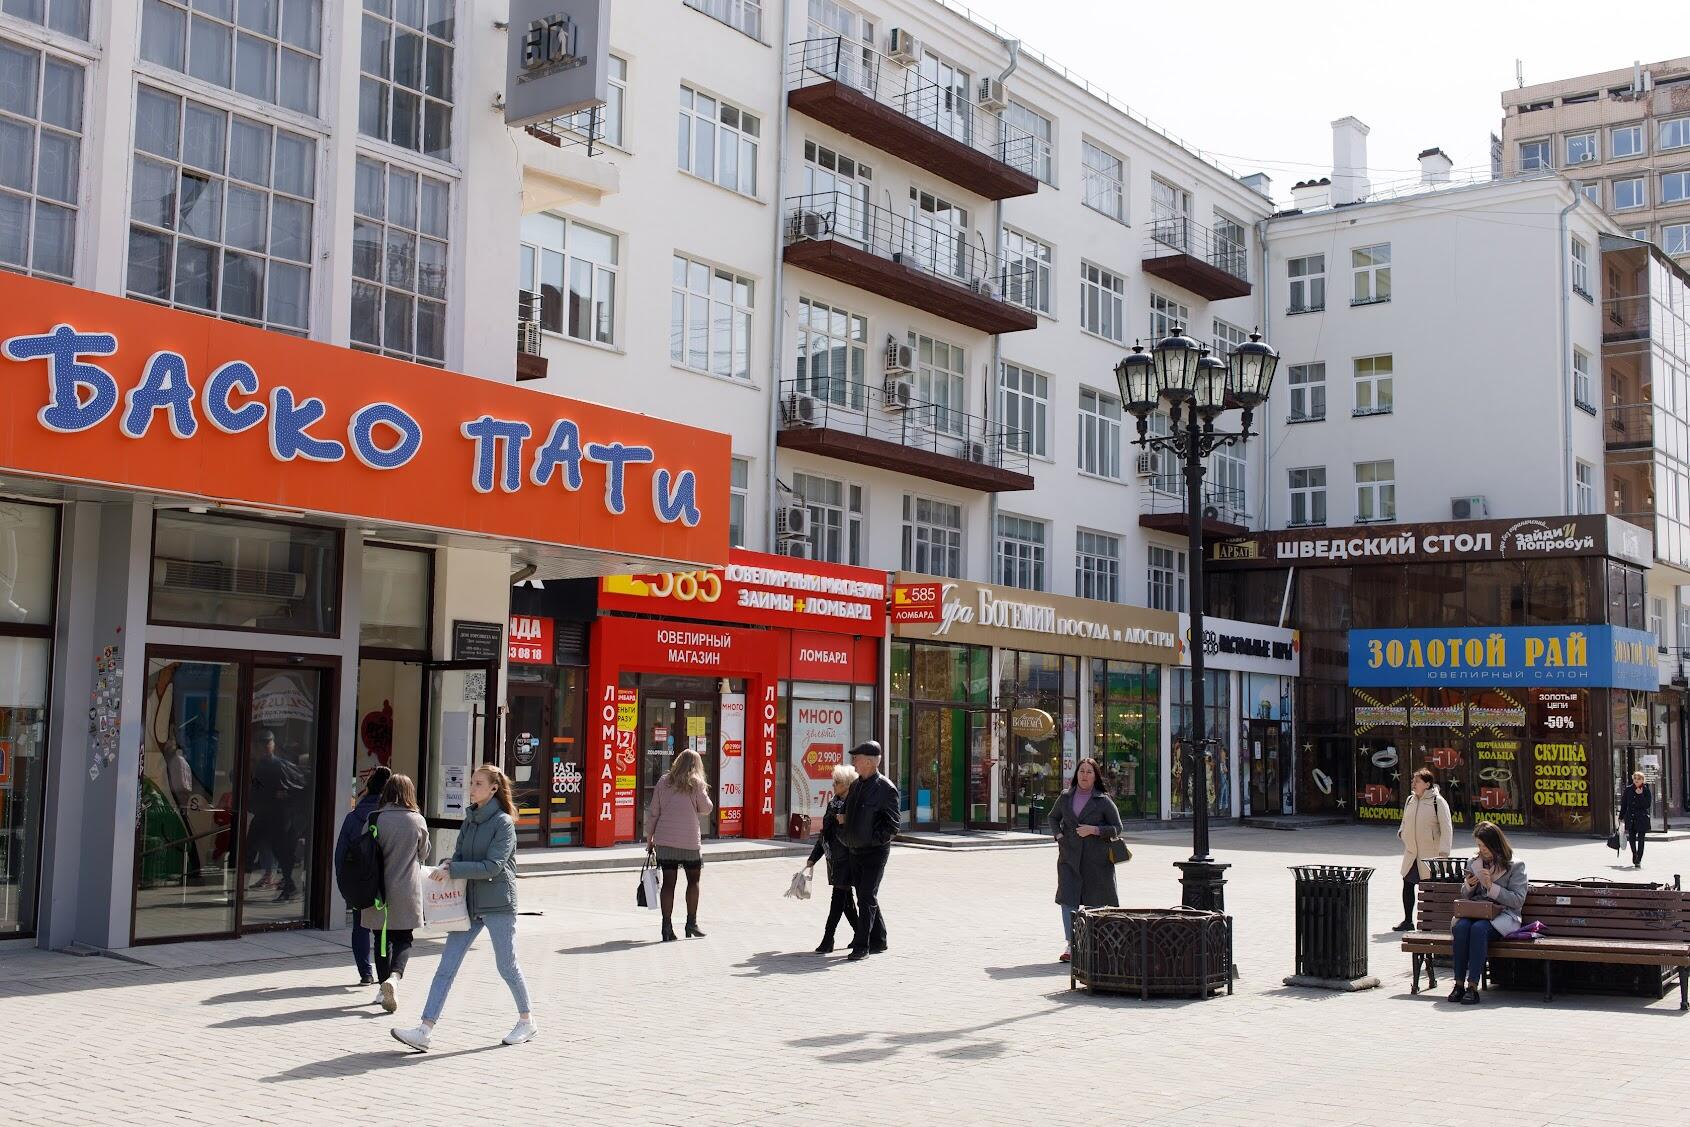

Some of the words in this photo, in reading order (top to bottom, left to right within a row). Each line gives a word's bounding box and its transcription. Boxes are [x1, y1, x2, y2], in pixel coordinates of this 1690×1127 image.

[1, 323, 423, 471] БАСКО
[460, 415, 701, 528] ПАТИ
[1219, 544, 1249, 559] АРБАТ
[1277, 532, 1415, 560] ШВЕДСКИЙ
[1422, 532, 1492, 554] СТОЛ
[725, 564, 821, 592] ЮВЕЛИРНЫЙ
[820, 576, 884, 600] МАГАЗИН
[912, 588, 935, 602] 585
[804, 597, 872, 620] ЛОМБАРД
[896, 611, 934, 619] ЛОМБАРД
[657, 629, 731, 648] ЮВЕЛИРНЫЙ
[1056, 618, 1110, 641] ПОСУДА
[1124, 627, 1175, 648] ЛЮСТРЫ
[519, 647, 530, 659] 08
[532, 648, 542, 660] 18
[668, 649, 720, 665] МАГАЗИН
[799, 649, 848, 664] ЛОМБАРД
[1368, 633, 1505, 668] ЗОЛОТОЙ
[1525, 632, 1588, 667] РАЙ
[1427, 671, 1525, 679] ЮВЕЛИРНЫЙ
[722, 703, 744, 711] МНОГО
[799, 709, 843, 724] МНОГО
[1544, 715, 1574, 729] -50%
[600, 685, 615, 821] ЛОМБАРД
[762, 686, 776, 815] ЛОМБАРД
[1479, 751, 1515, 760] КОЛЬЦА
[1534, 744, 1586, 761] СКУПКА
[553, 762, 576, 773] FAST
[1535, 765, 1587, 777] ЗОЛОТО
[553, 772, 582, 783] FOOD
[553, 783, 580, 793] COOK
[721, 783, 741, 795] -70%
[1535, 779, 1587, 791] СЕРЕБРО
[1533, 792, 1589, 807] ОБМЕН
[728, 809, 741, 819] 585
[1475, 812, 1524, 825] РАССРОЧКА
